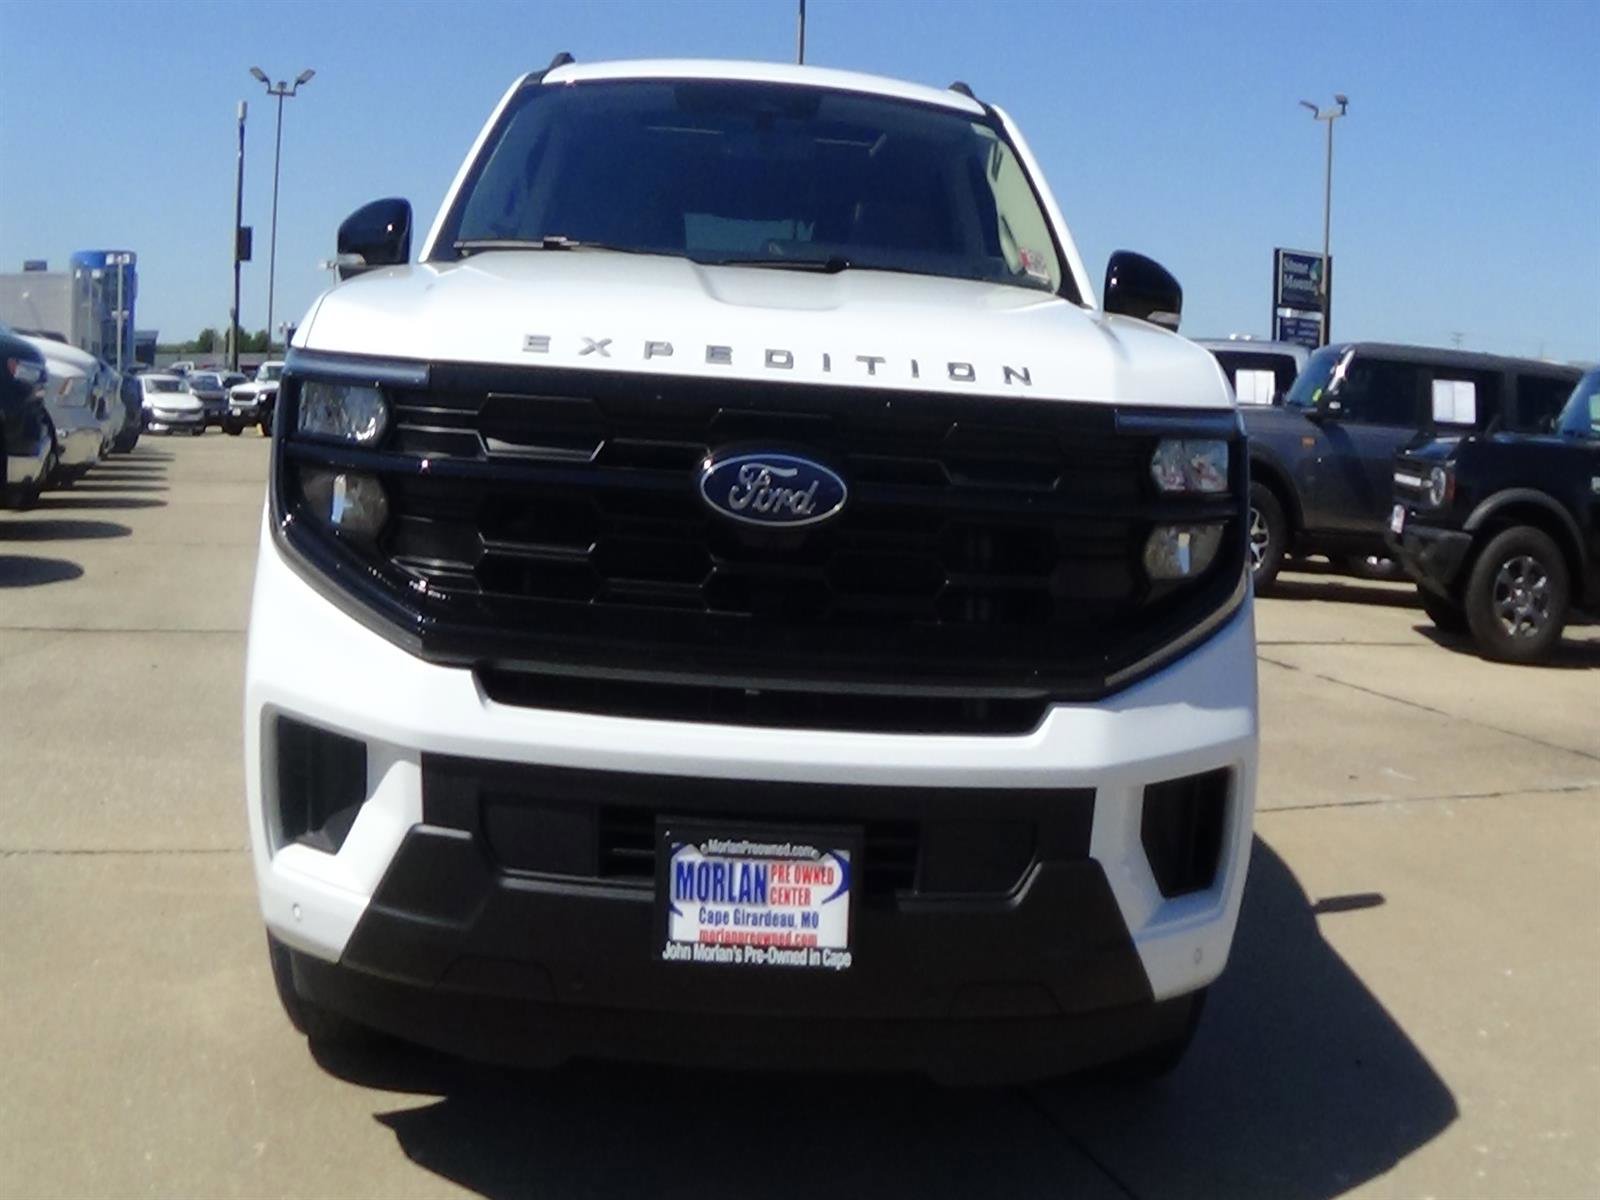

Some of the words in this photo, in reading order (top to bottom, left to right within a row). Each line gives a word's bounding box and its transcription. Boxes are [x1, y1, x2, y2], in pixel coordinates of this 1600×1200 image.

[522, 333, 1033, 386] EXPEDITION
[728, 463, 817, 515] Ford
[675, 861, 767, 903] MORLAN
[770, 864, 791, 884] PRE
[794, 866, 834, 885] OWNED
[769, 886, 811, 905] CENTER
[698, 907, 730, 926] Cape
[801, 911, 819, 928] MO
[662, 942, 692, 961] John
[693, 944, 743, 964] Morlan's
[744, 946, 808, 966] Pre-Owned
[822, 948, 852, 970] Cape
